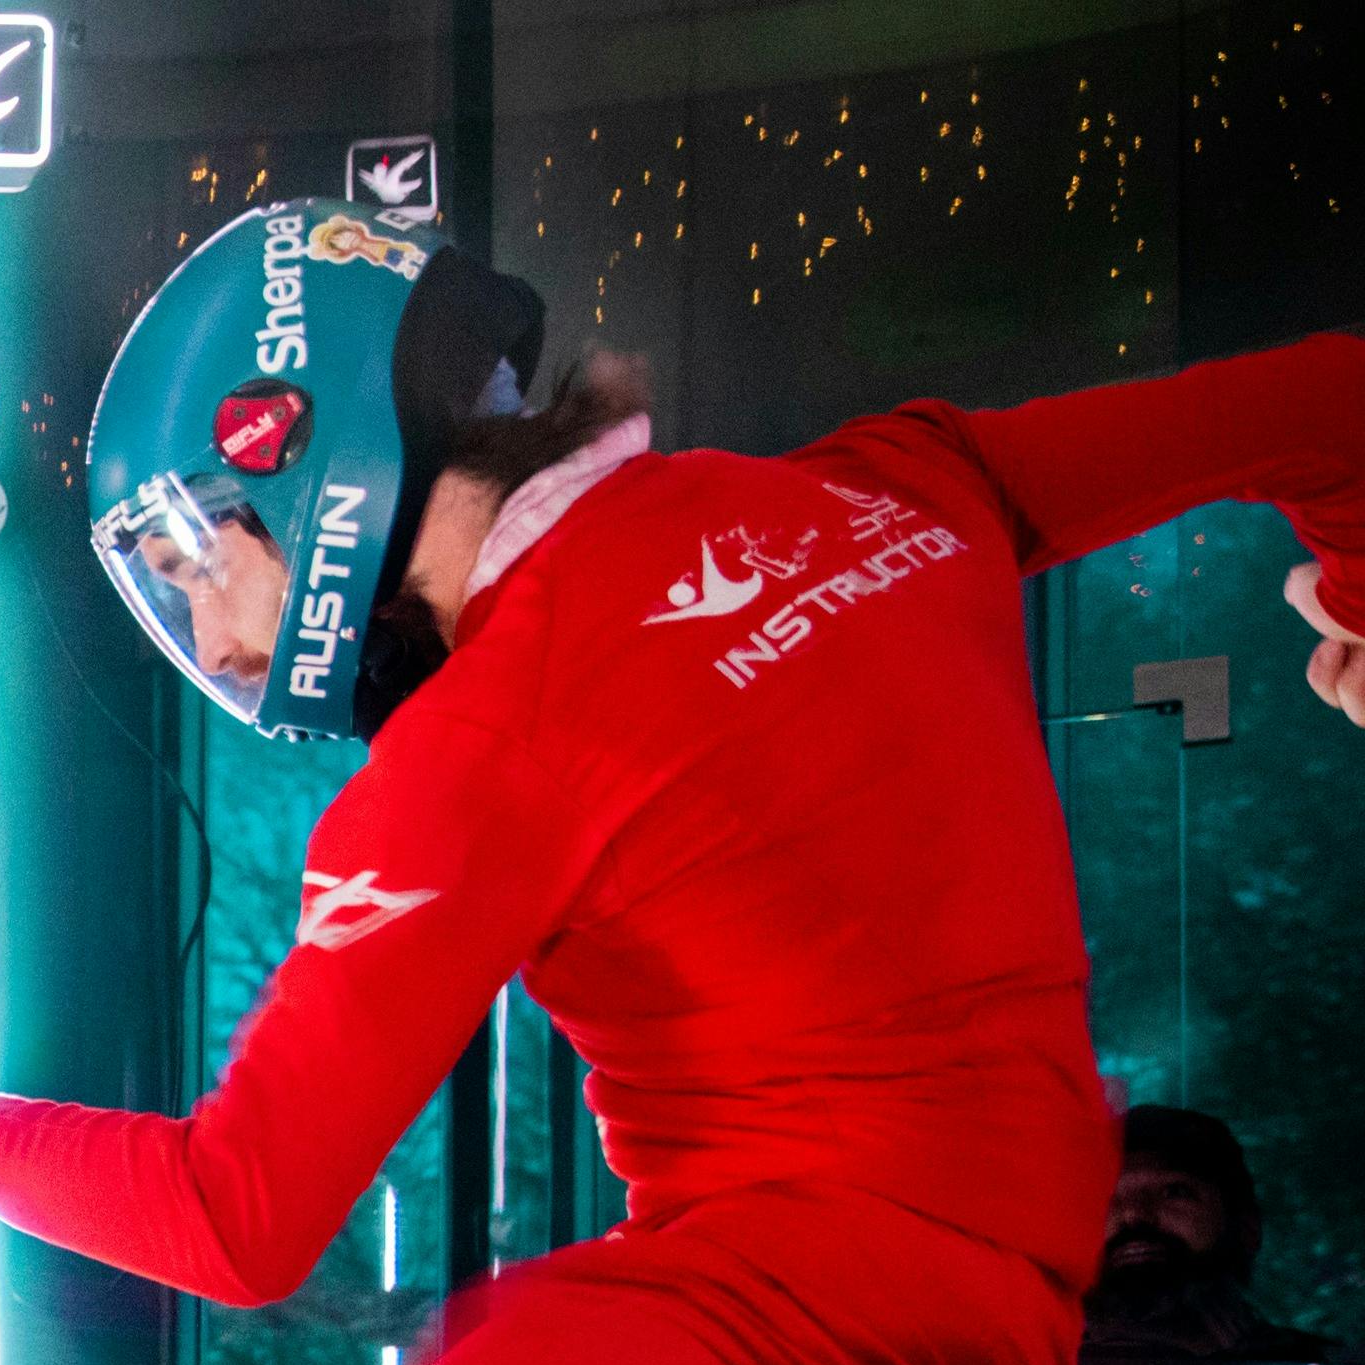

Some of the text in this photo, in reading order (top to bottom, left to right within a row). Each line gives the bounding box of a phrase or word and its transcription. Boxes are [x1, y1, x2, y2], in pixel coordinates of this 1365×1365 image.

[255, 213, 308, 374] Sherpa
[289, 485, 367, 698] AUSTIN
[713, 527, 968, 689] INSTRUCTOR
